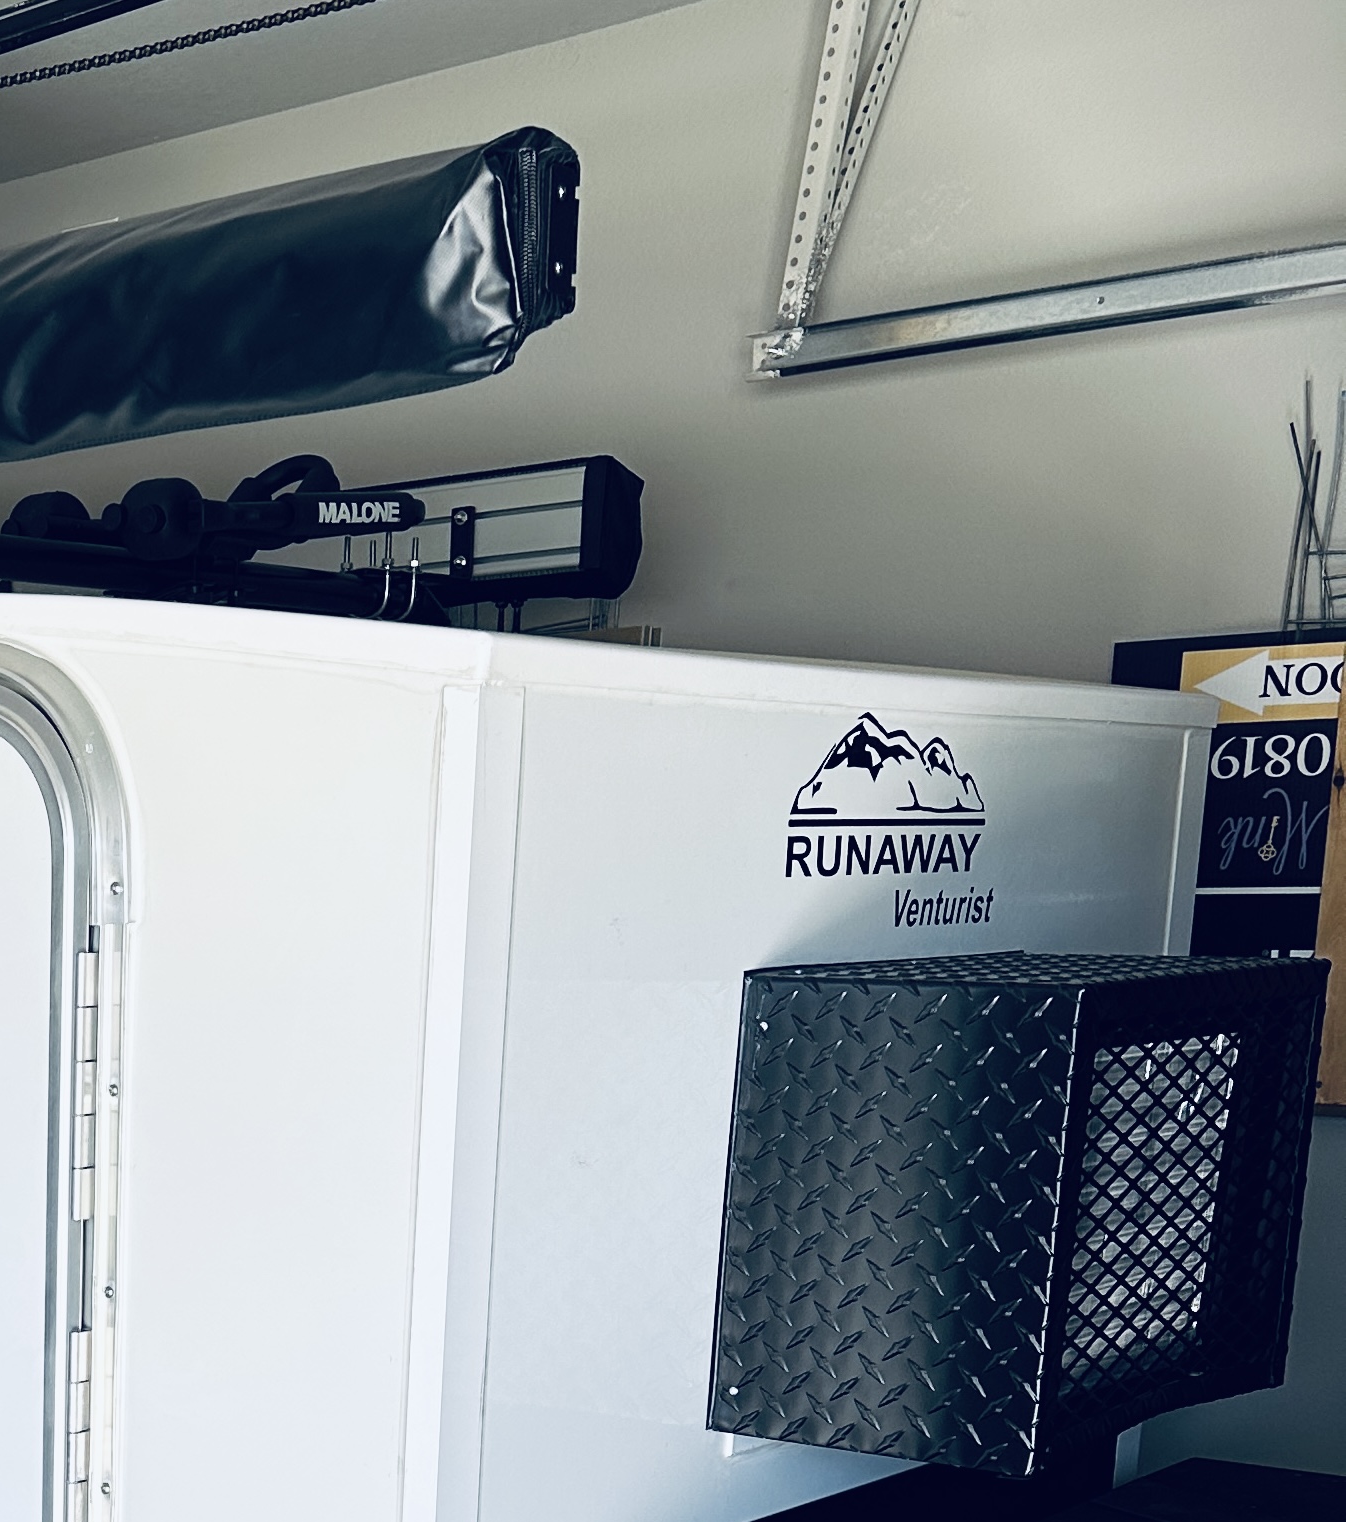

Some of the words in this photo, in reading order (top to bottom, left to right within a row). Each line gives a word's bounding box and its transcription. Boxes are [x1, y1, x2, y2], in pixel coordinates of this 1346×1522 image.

[318, 501, 401, 524] MALONE
[1210, 733, 1331, 779] 0819
[785, 833, 982, 878] RUNAWAY
[894, 886, 994, 927] Venturist
